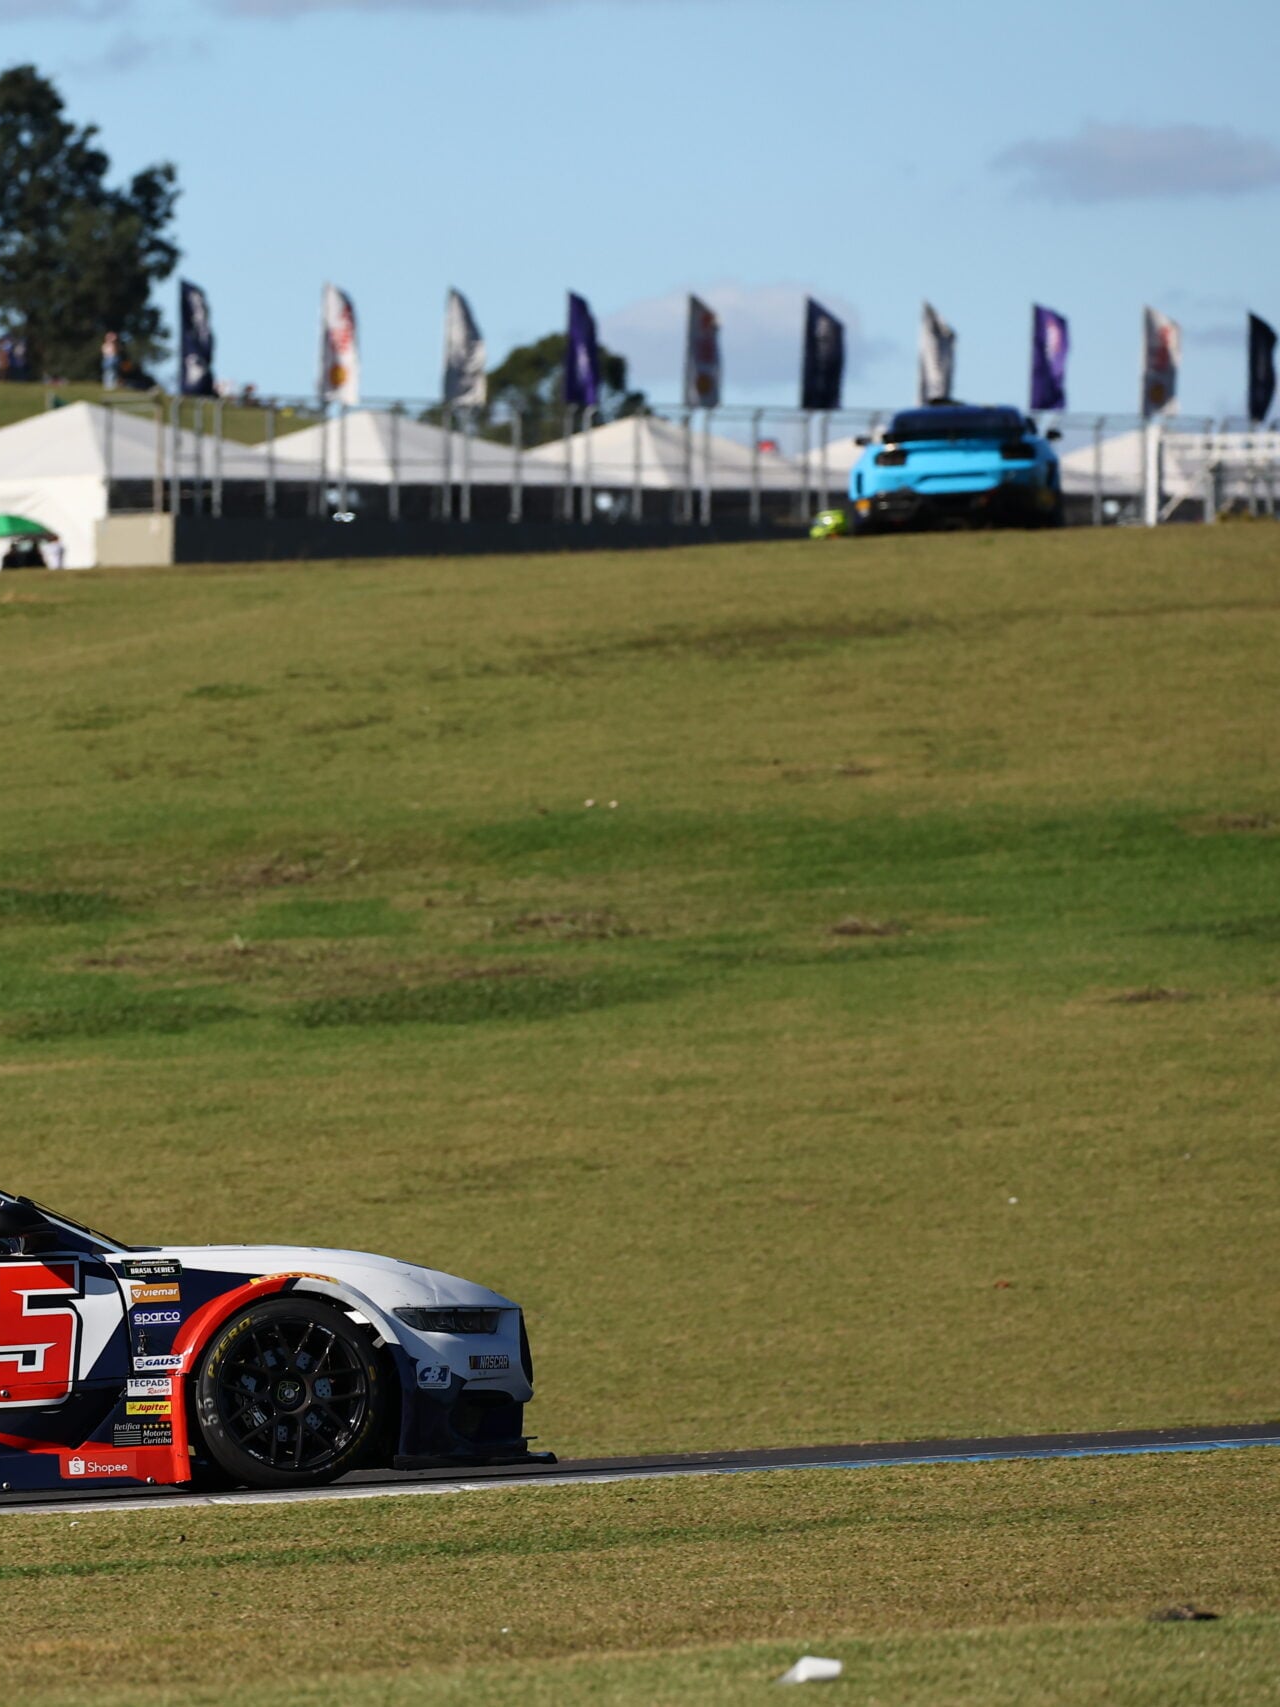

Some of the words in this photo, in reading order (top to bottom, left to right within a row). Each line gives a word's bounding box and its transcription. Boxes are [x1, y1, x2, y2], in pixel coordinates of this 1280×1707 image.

[143, 1288, 178, 1297] viemar
[134, 1311, 181, 1325] sparco
[145, 1357, 182, 1367] GAUSS
[480, 1355, 508, 1369] NASCAR
[129, 1380, 170, 1388] TECPADS
[87, 1461, 128, 1475] Shopee
